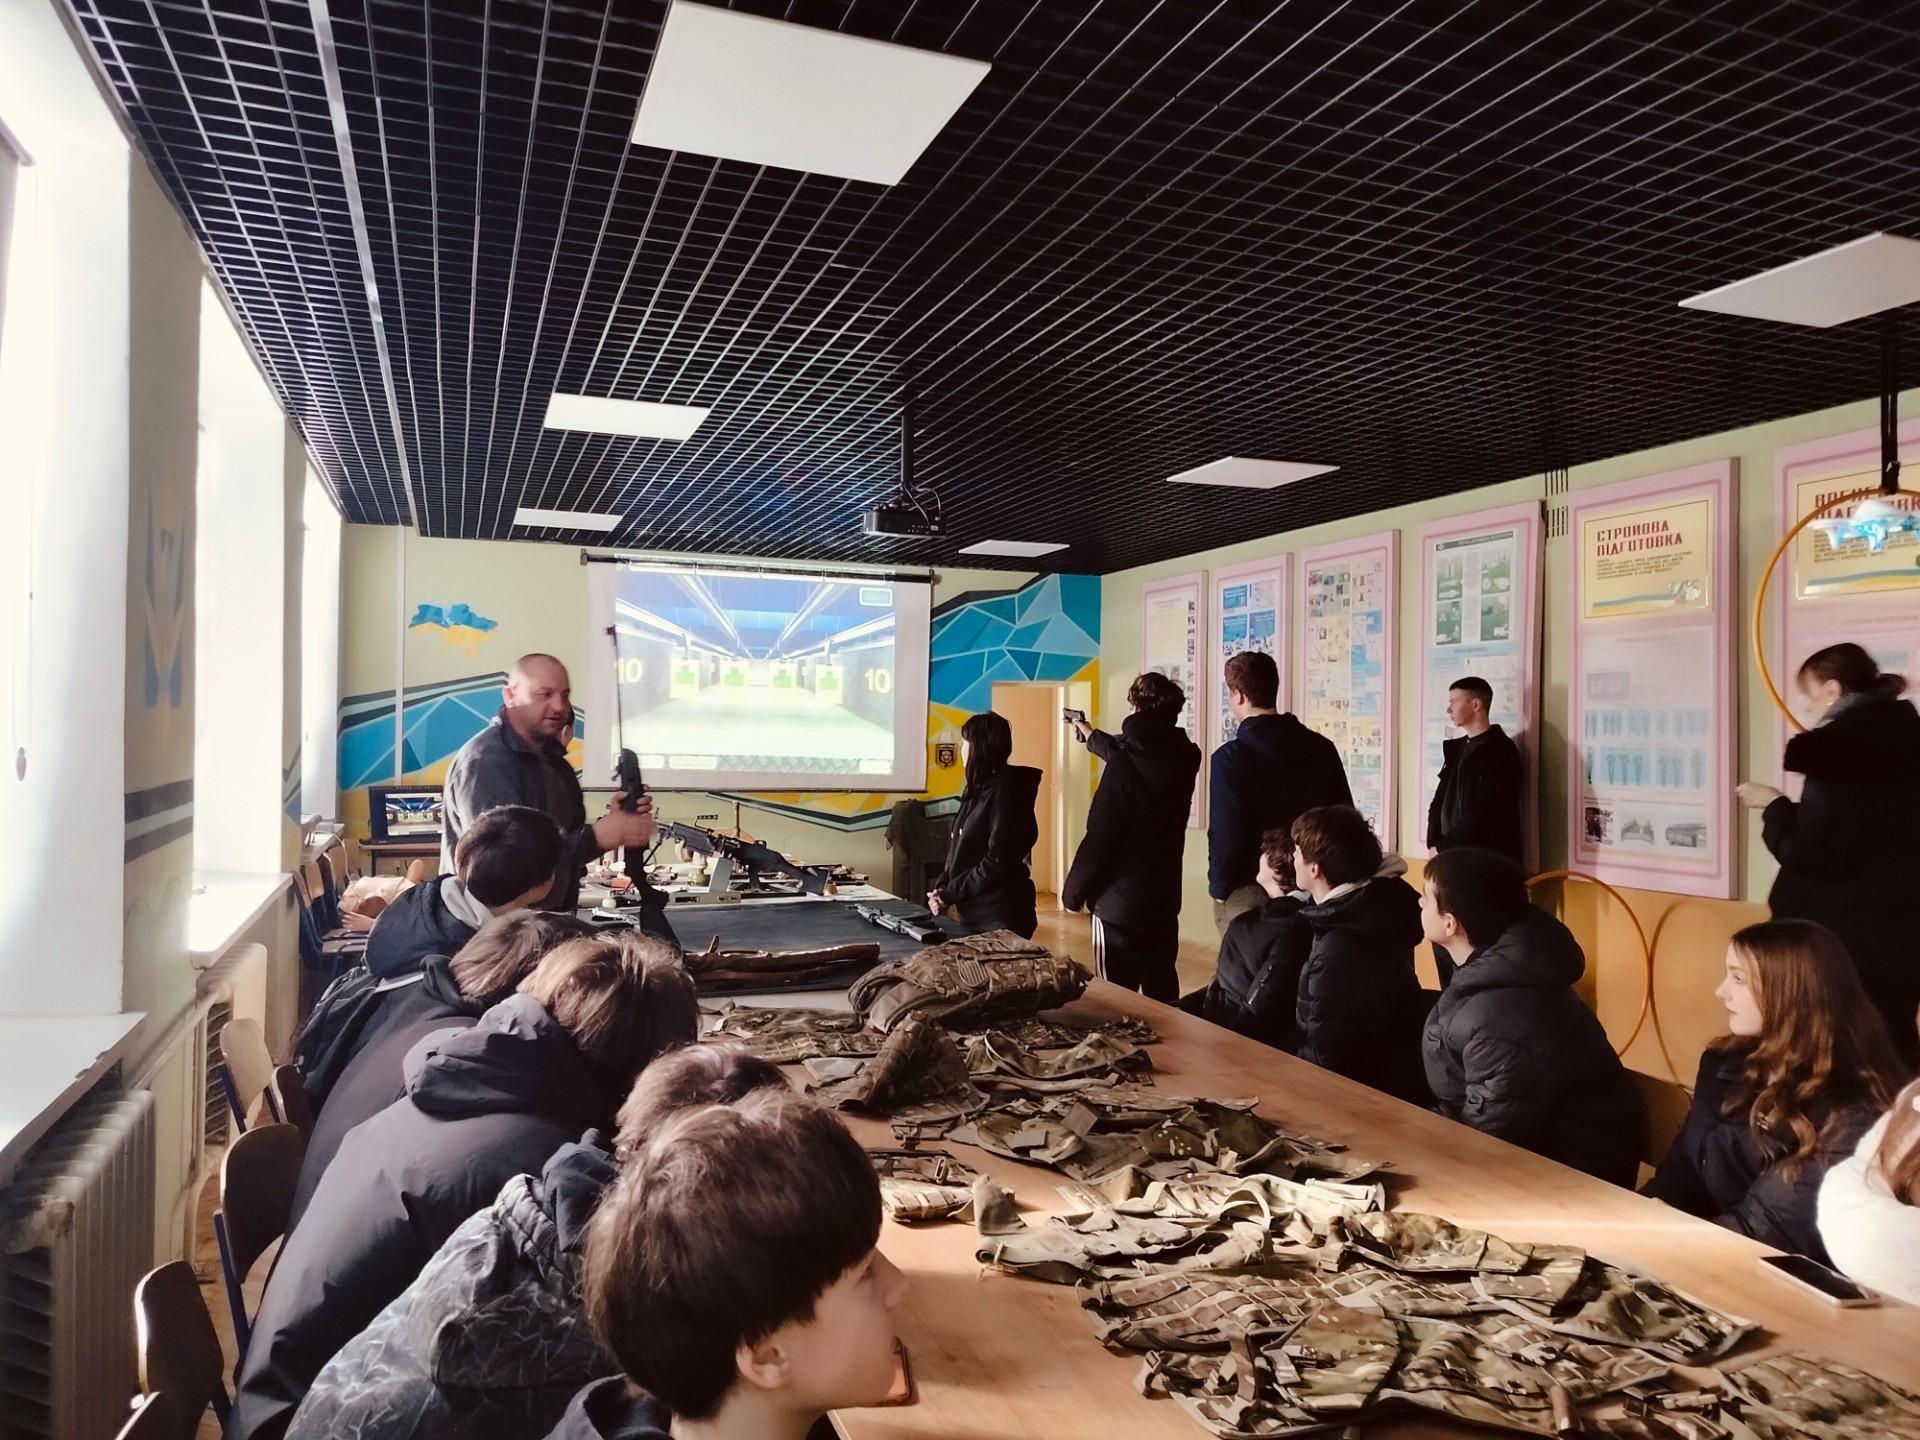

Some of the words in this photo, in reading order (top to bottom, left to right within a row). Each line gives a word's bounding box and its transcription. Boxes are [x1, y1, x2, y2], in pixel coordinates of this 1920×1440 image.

[1597, 519, 1669, 542] СТРОЙОВА
[1597, 532, 1682, 557] ПІДГОТОВКА
[614, 657, 643, 684] 10
[864, 667, 891, 693] 10
